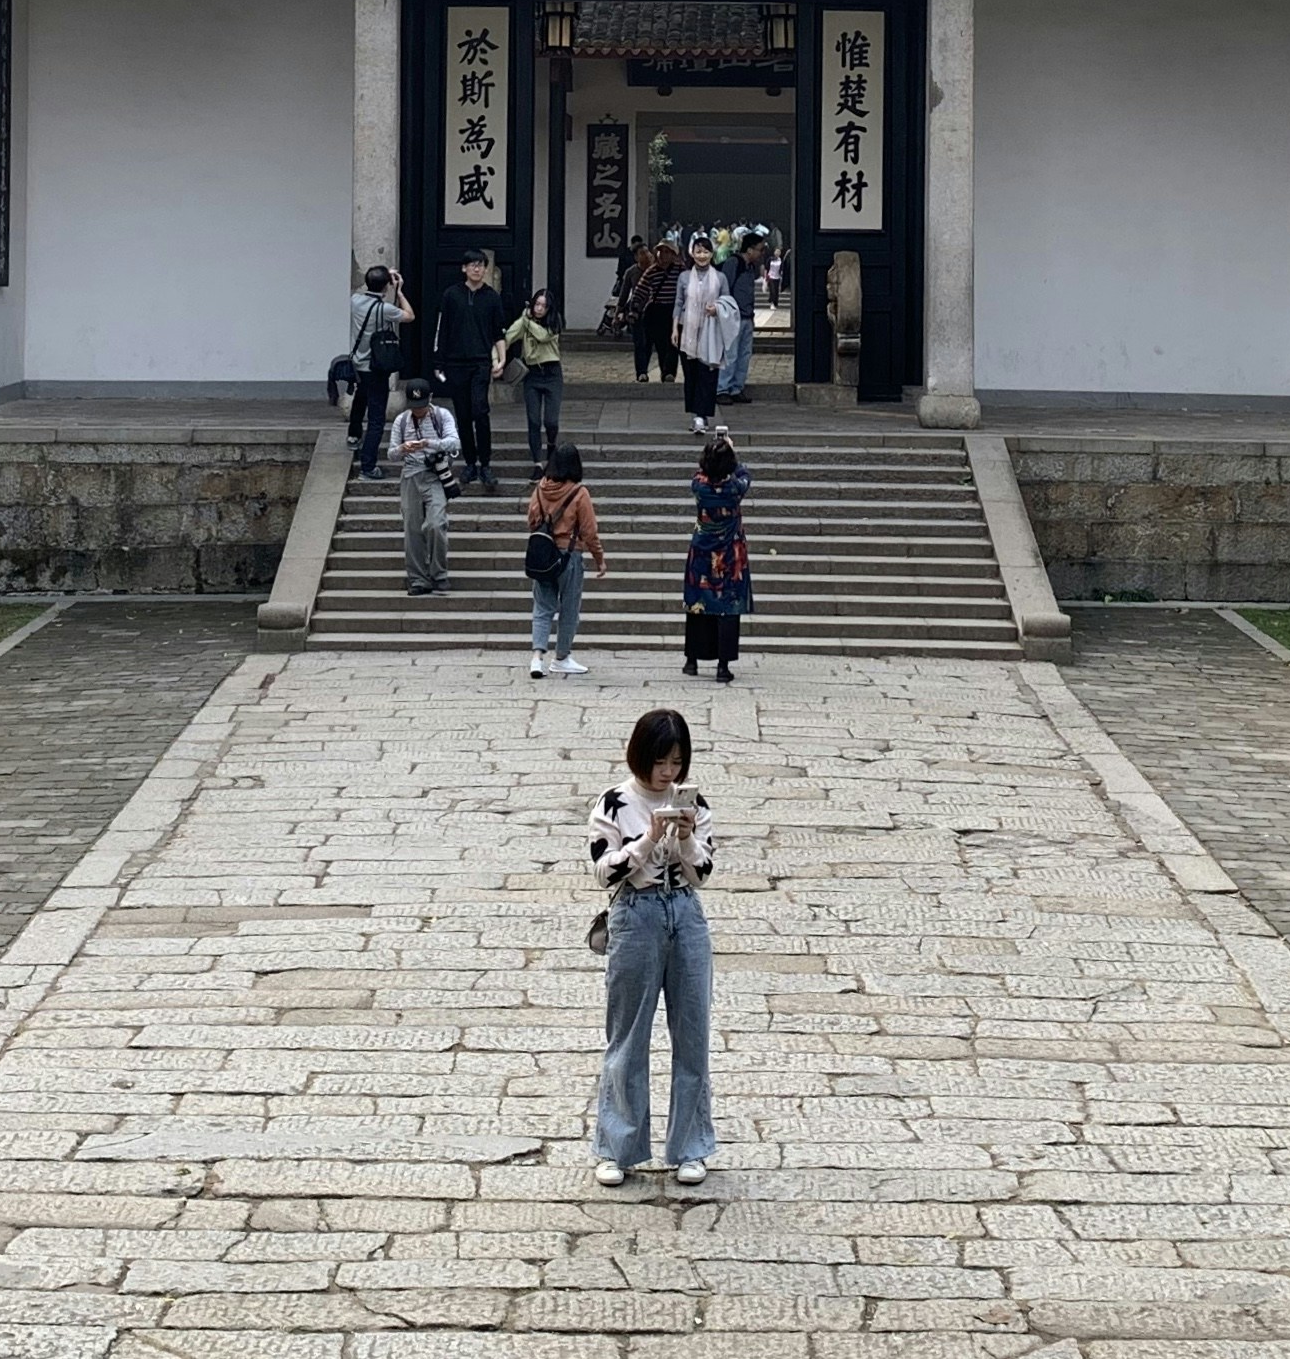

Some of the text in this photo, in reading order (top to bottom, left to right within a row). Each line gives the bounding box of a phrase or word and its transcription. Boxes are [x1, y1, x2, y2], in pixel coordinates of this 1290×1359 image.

[592, 133, 624, 250] 藏之名山
[832, 30, 871, 213] 惟楚有材
